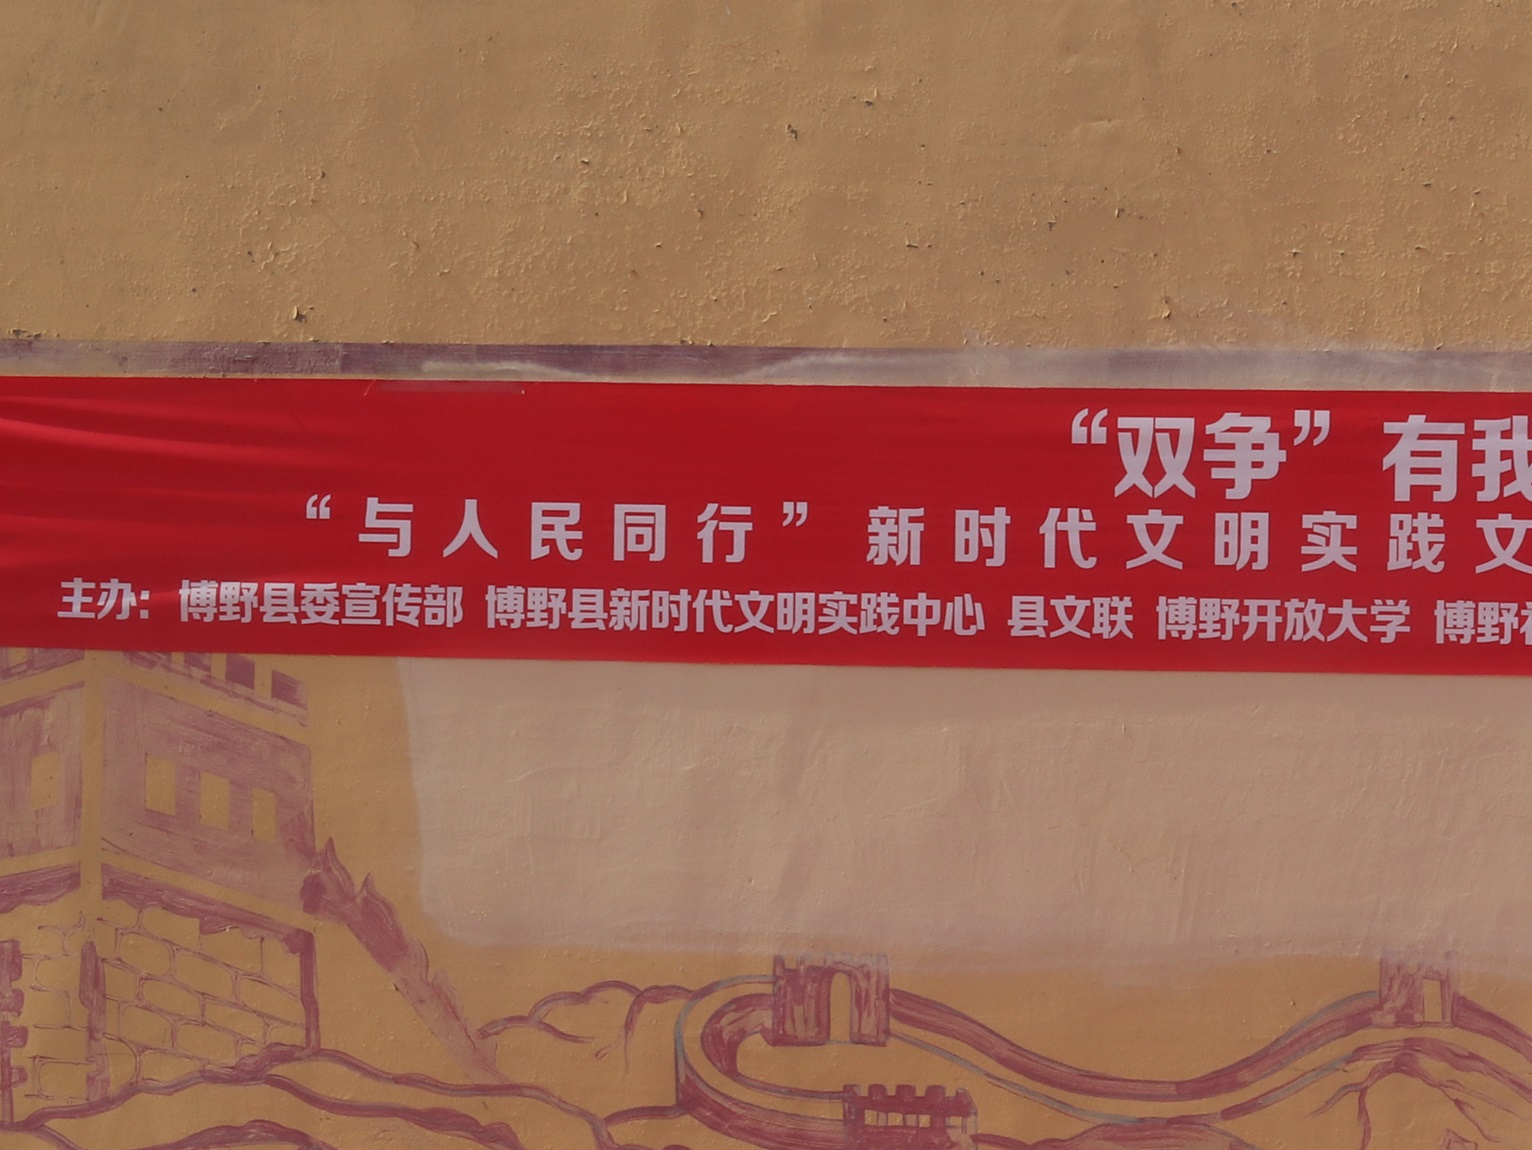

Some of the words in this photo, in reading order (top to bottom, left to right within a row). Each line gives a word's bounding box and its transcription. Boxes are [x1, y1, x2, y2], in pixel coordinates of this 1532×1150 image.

[486, 585, 984, 636] 博野县新时代文明实践中心
[1008, 595, 1133, 638] 县文联
[1156, 596, 1410, 643] 博野开放大学
